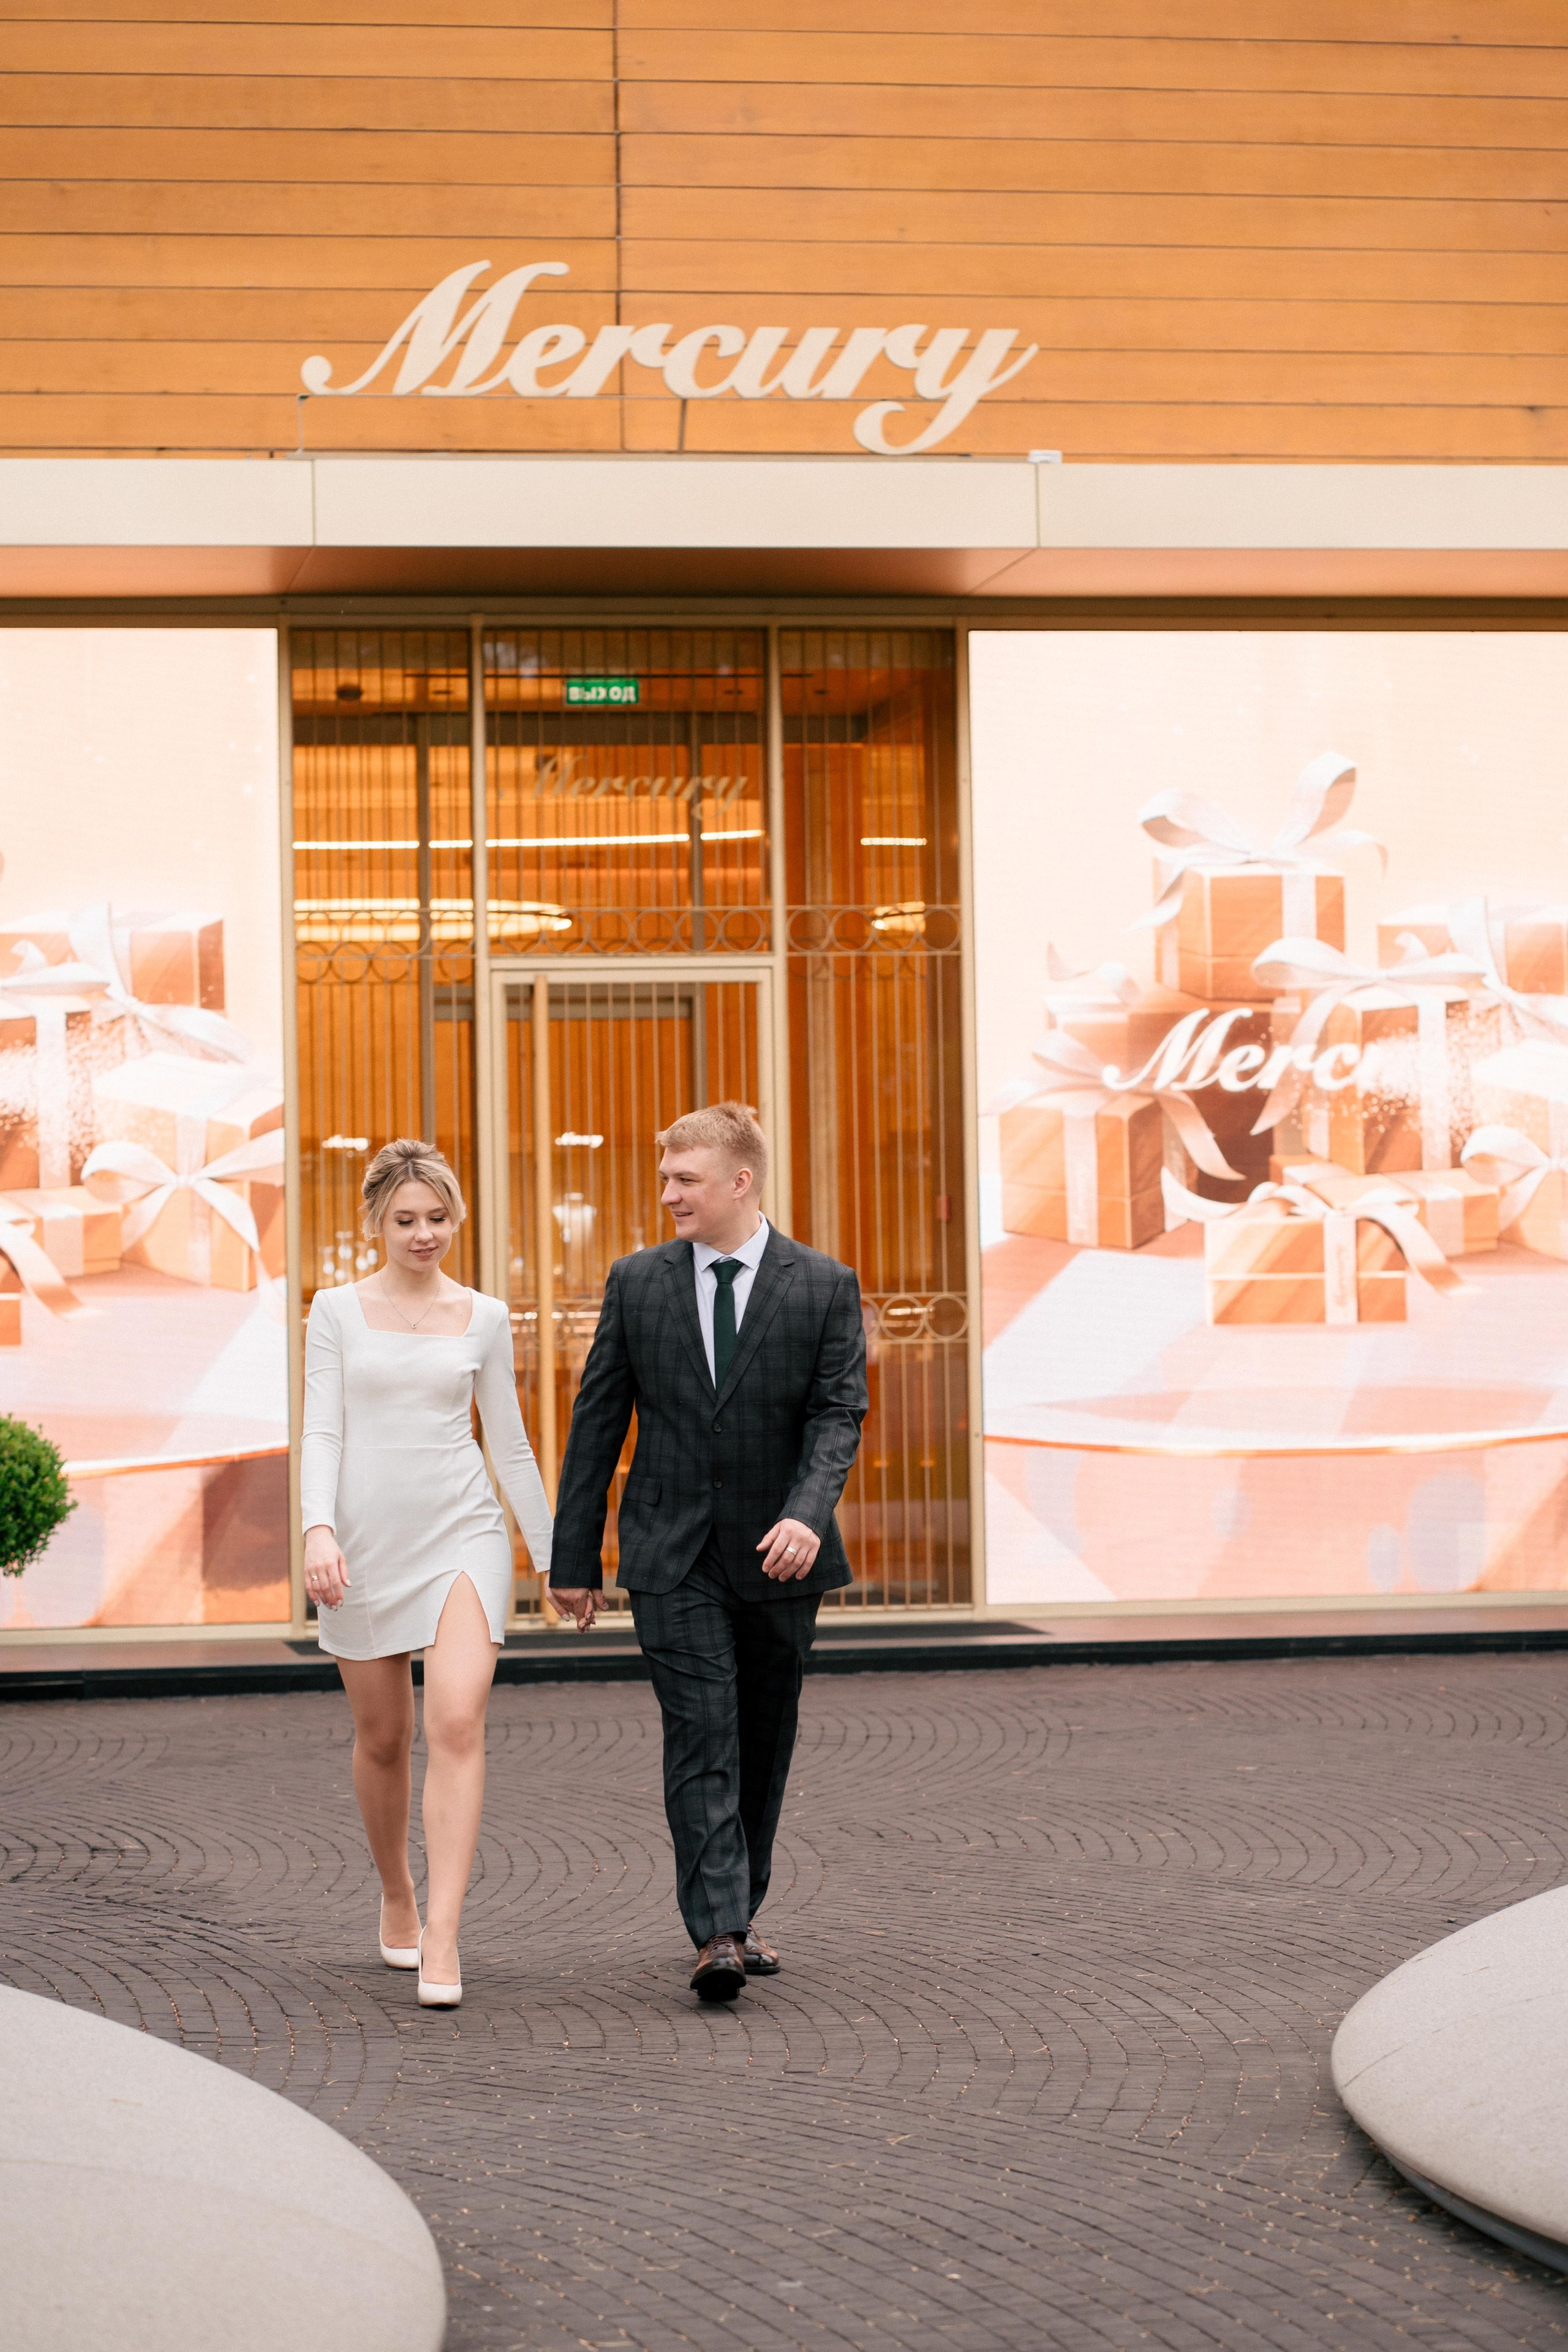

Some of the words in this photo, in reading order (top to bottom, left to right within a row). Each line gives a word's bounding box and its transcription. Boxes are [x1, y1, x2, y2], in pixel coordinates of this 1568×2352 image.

[301, 259, 1039, 455] Mercury
[568, 685, 636, 703] ВЫХОД
[499, 755, 750, 820] Mercury
